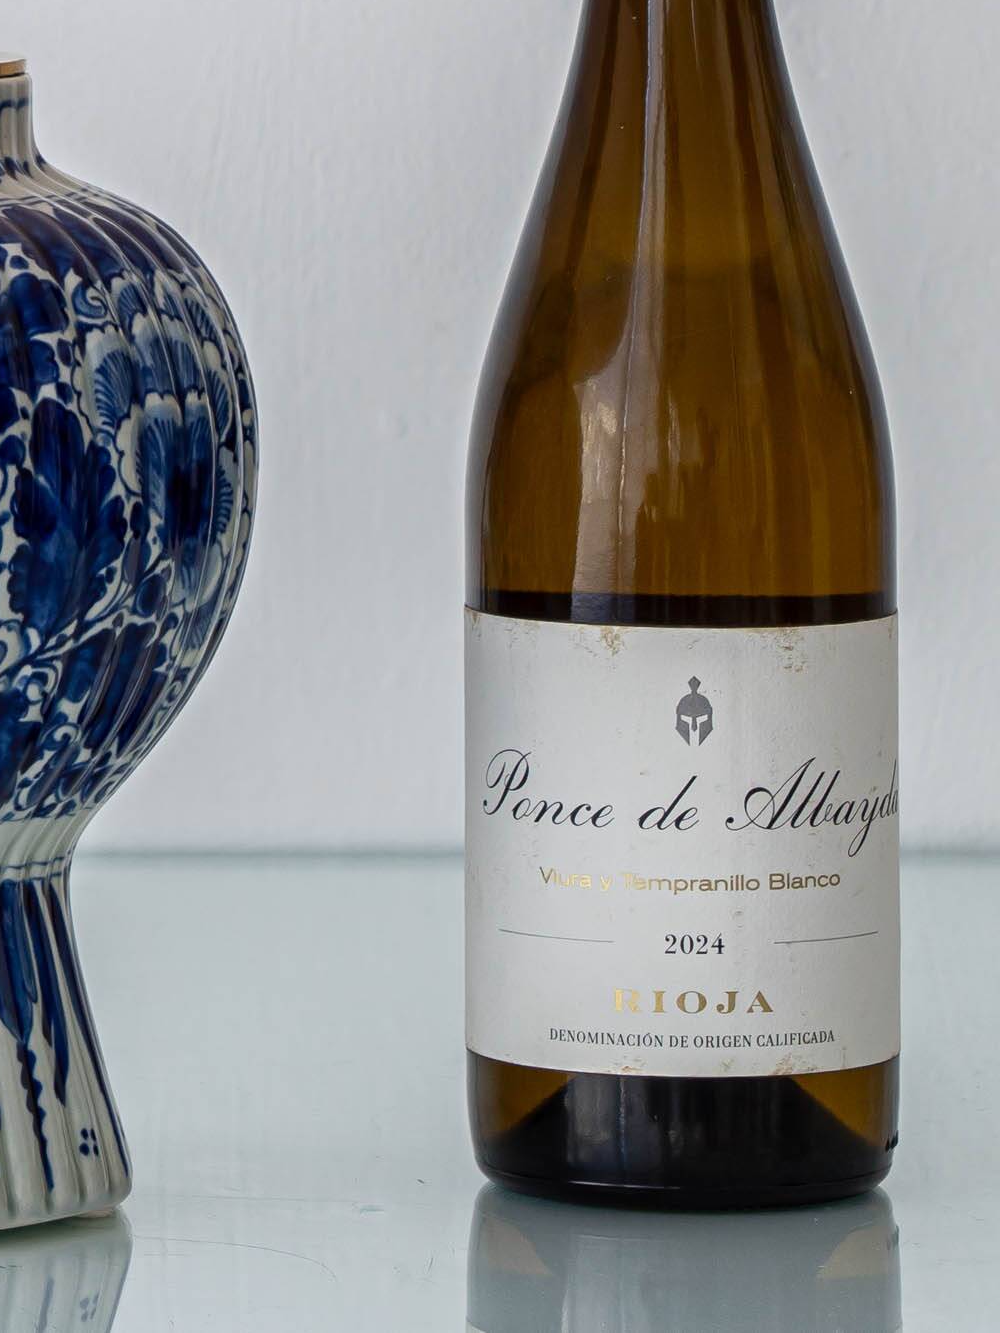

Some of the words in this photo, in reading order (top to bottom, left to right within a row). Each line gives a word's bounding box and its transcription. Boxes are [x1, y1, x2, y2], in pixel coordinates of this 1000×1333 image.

[483, 749, 615, 828] Ponce
[637, 775, 700, 831] de
[539, 866, 593, 890] Viura
[600, 873, 612, 891] y
[622, 872, 761, 896] Tempranillo
[768, 872, 841, 891] Blanco
[664, 933, 725, 955] 2024
[615, 988, 774, 1014] RIOJA
[549, 1027, 664, 1047] DENOMINACIÓN
[669, 1034, 689, 1048] DE
[693, 1034, 752, 1048] ORIGEN
[756, 1029, 835, 1047] CALIFICADA
